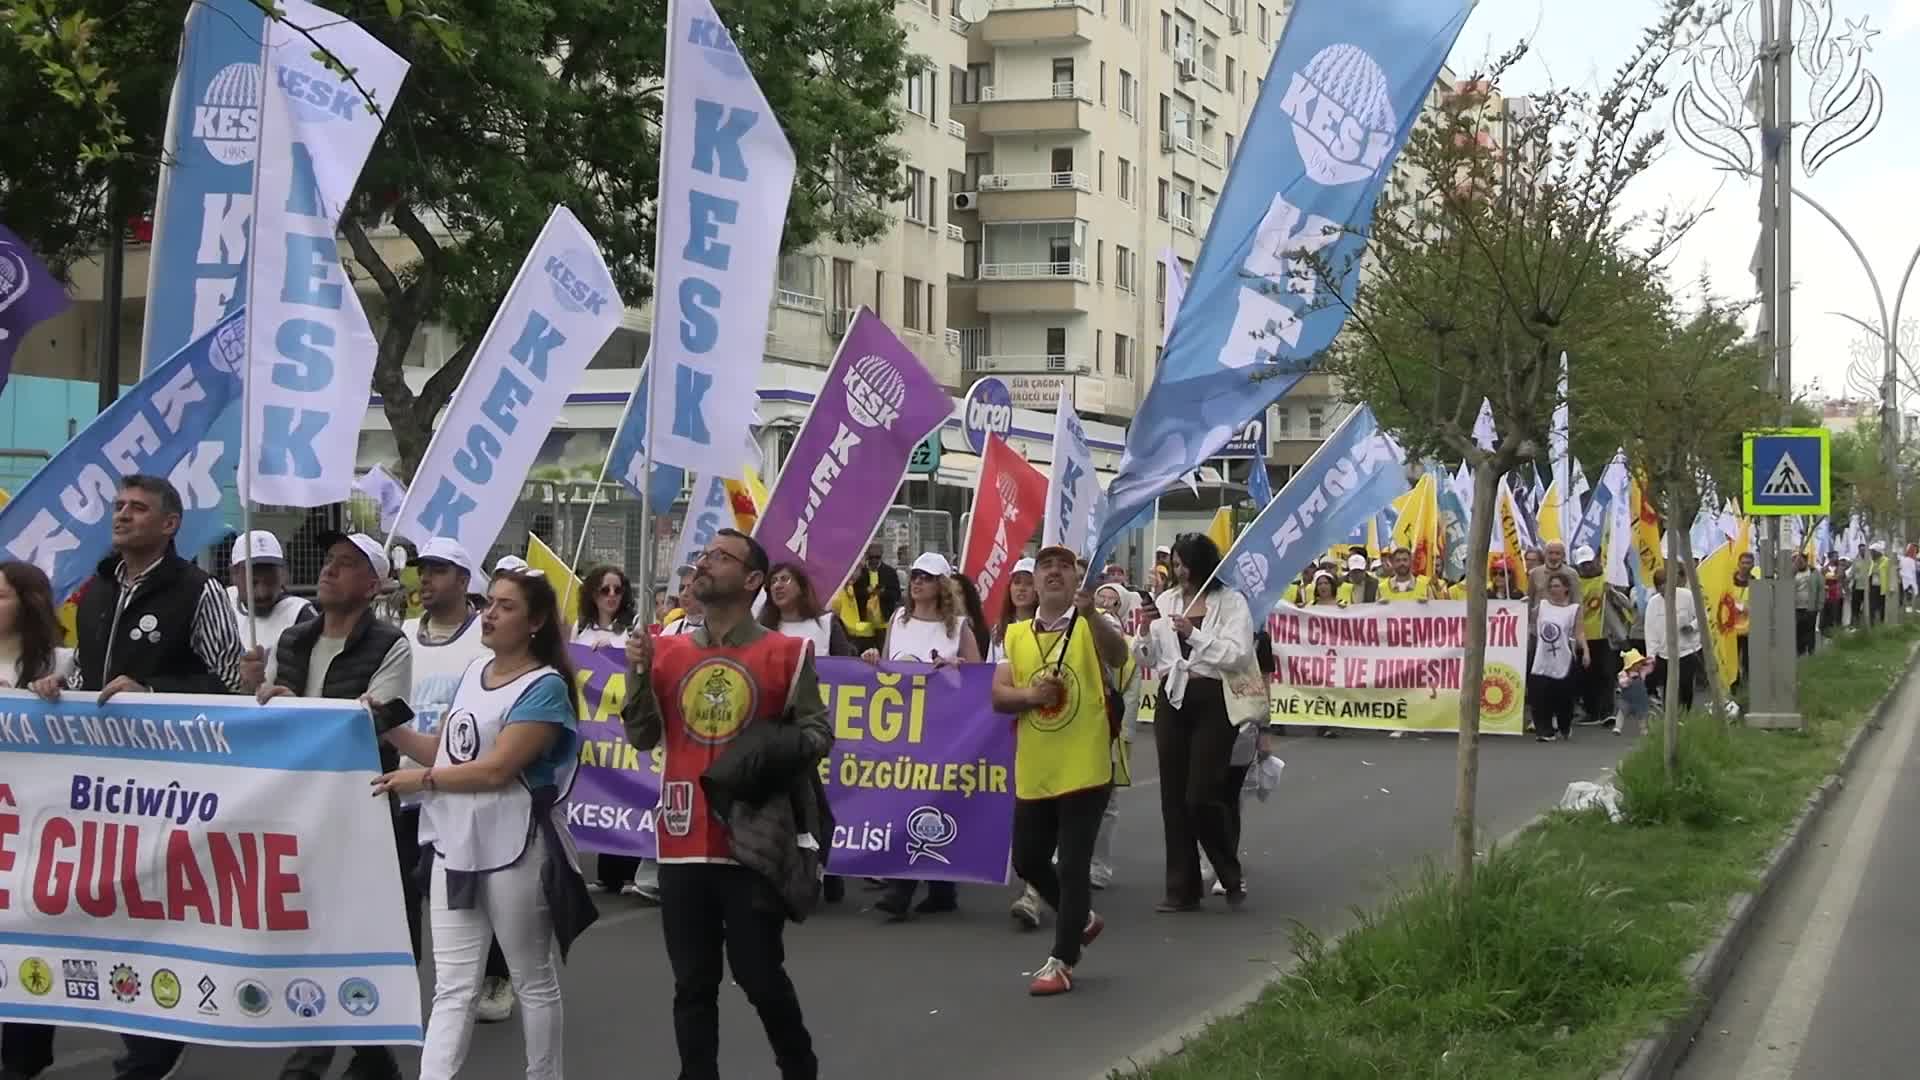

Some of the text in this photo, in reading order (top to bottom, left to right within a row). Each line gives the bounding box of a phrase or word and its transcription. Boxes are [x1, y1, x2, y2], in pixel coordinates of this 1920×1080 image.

[193, 107, 257, 139] KES
[544, 255, 608, 316] KESK
[671, 98, 759, 445] KESK
[842, 365, 900, 431] KESK
[417, 309, 567, 540] KESK
[1307, 616, 1381, 648] CIVAKA
[1287, 648, 1338, 688] KEDÊ
[1343, 659, 1368, 689] VE
[1303, 695, 1338, 717] YÊN
[1340, 698, 1408, 720] AMEDÊ
[44, 712, 232, 755] DEMOKRATÎK
[839, 752, 1008, 798] ÖZGÜRLEŞİR
[70, 774, 219, 826] Biciwîyo
[567, 802, 634, 831] KESK
[32, 816, 310, 931] GULANE
[67, 980, 98, 1001] BTS
